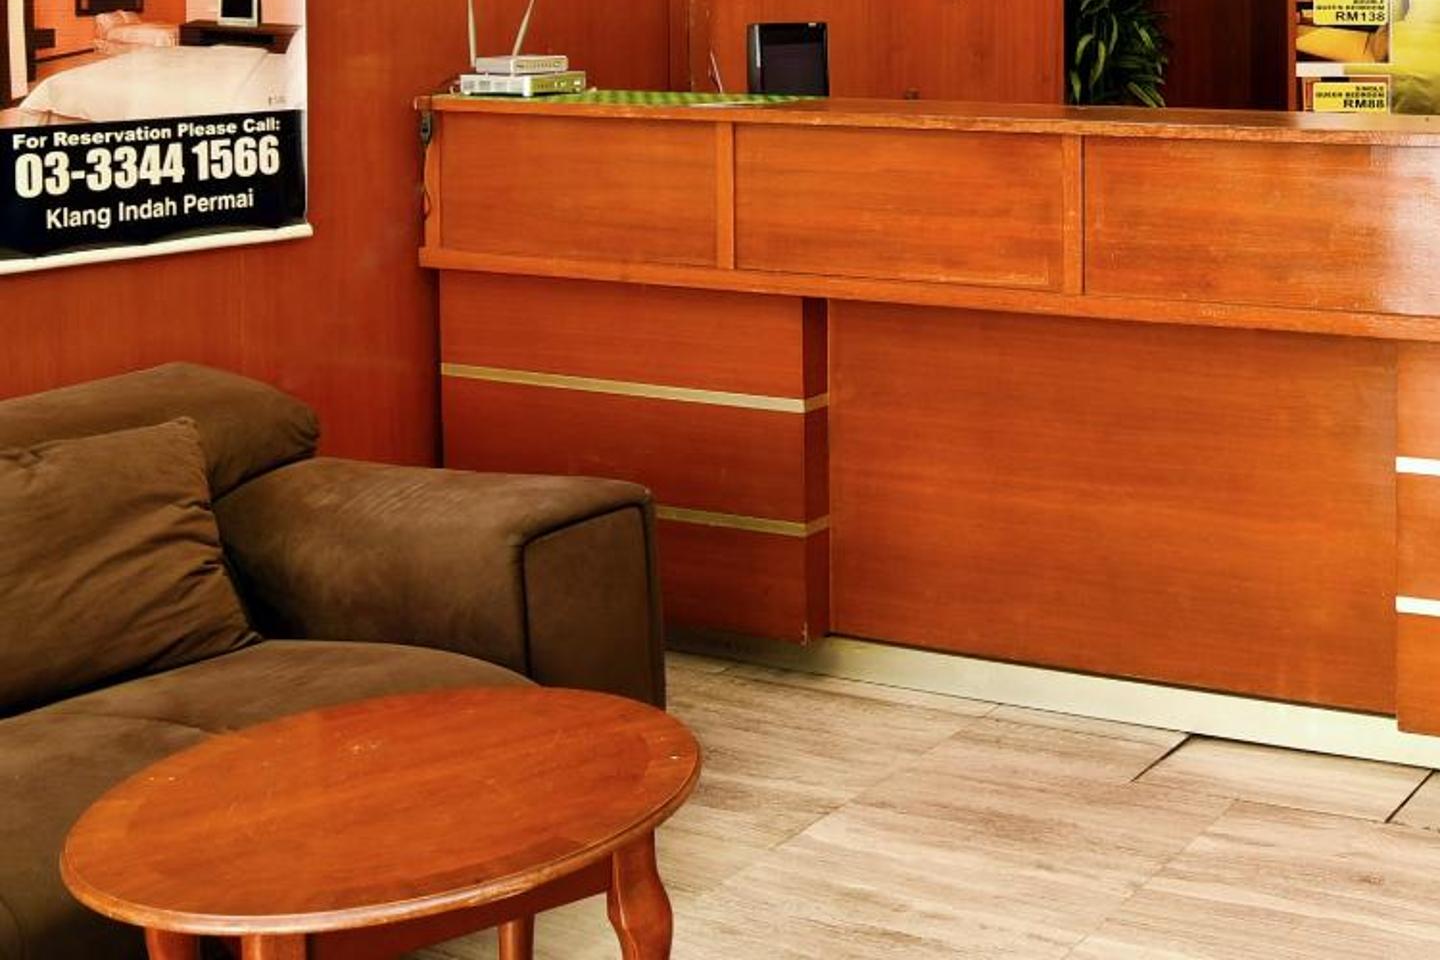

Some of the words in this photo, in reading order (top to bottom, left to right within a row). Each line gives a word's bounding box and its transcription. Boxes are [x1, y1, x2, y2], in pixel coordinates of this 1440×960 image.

[1336, 11, 1385, 22] RM138
[12, 133, 48, 151] For
[53, 125, 172, 147] Reservation
[178, 121, 238, 138] Please
[242, 116, 282, 133] Call:
[14, 142, 186, 199] 03-3344
[191, 134, 281, 182] 1566
[46, 206, 112, 230] Klang
[118, 197, 178, 222] Indah
[183, 188, 255, 215] Permai
